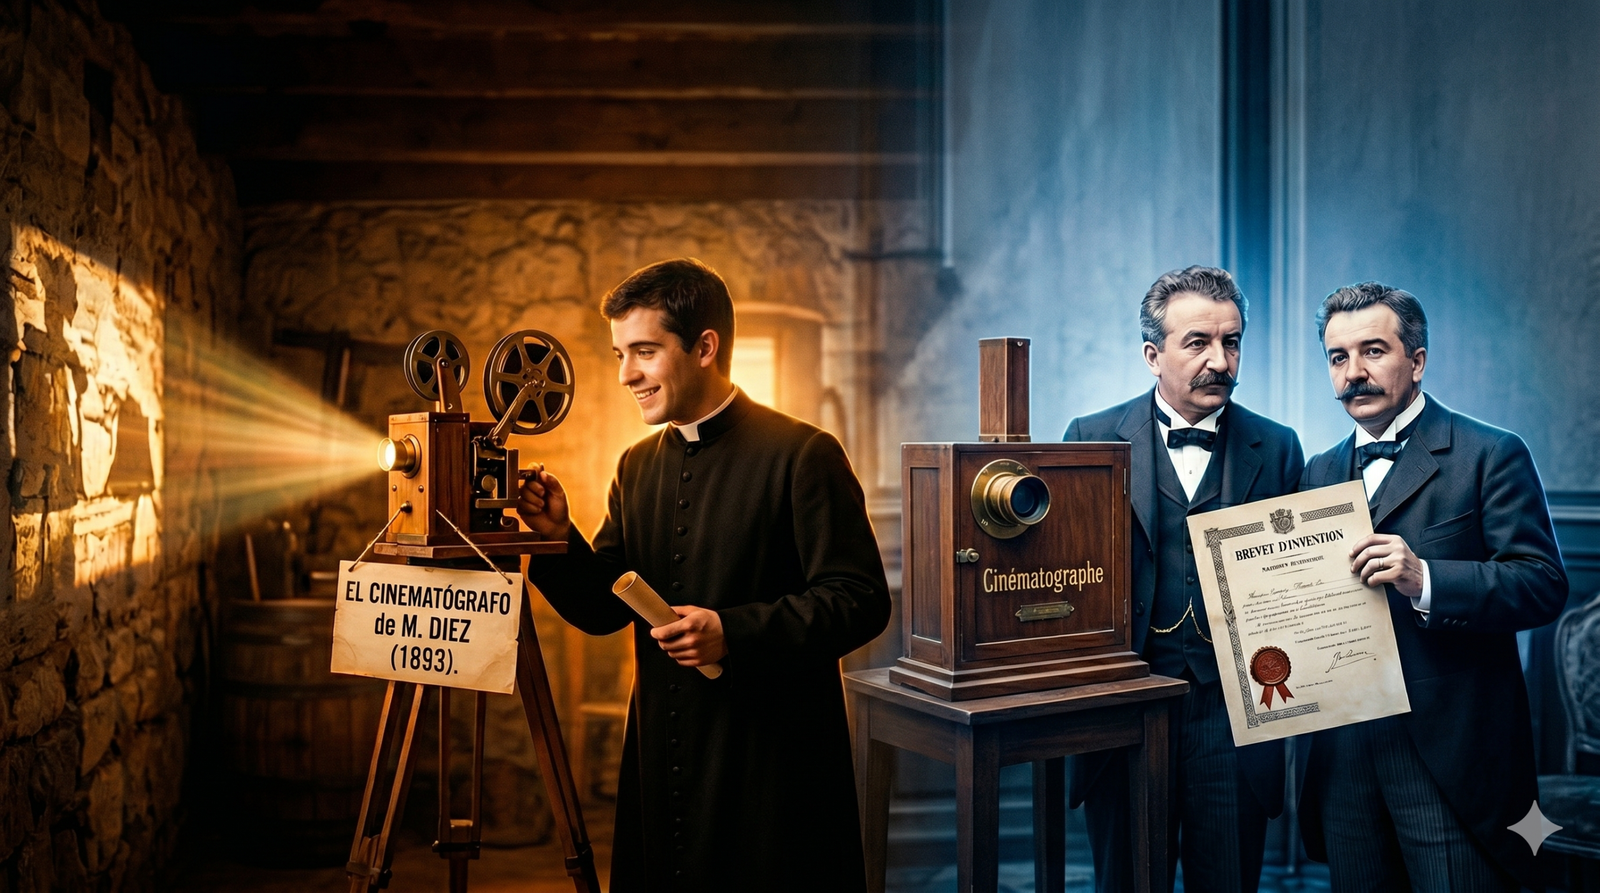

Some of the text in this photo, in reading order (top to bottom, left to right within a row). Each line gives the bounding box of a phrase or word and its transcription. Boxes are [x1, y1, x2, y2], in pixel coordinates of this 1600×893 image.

[1235, 529, 1344, 561] BREVET D'INVENTION
[983, 560, 1104, 593] Cinématographe
[345, 581, 511, 615] EL CINEMATÓGRAFO
[374, 613, 472, 643] de M. DIEZ
[390, 644, 458, 675] (1893).
